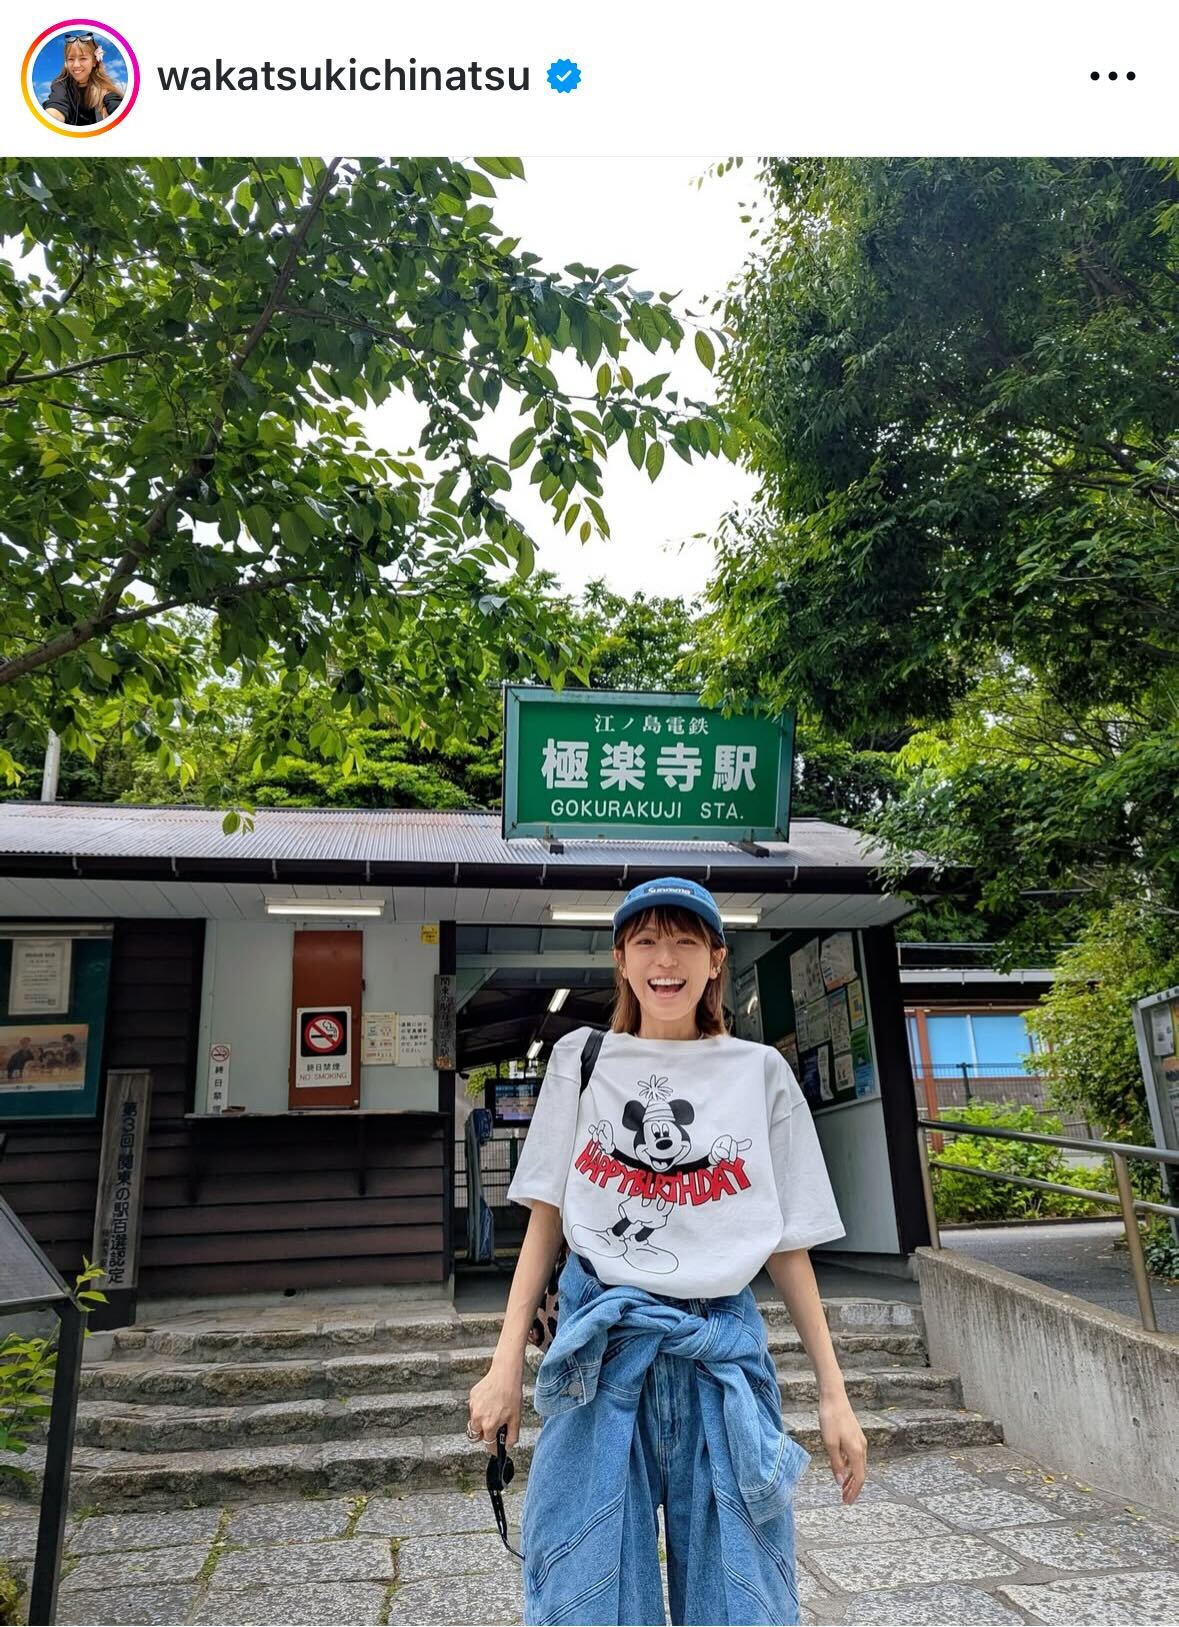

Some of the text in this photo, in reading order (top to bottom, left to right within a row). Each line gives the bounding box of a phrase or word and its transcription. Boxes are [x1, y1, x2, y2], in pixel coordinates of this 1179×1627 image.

[594, 714, 709, 735] 江ノ島電鉄
[541, 738, 757, 792] 極楽寺駅
[551, 799, 744, 819] GOKURAKUJI STA.
